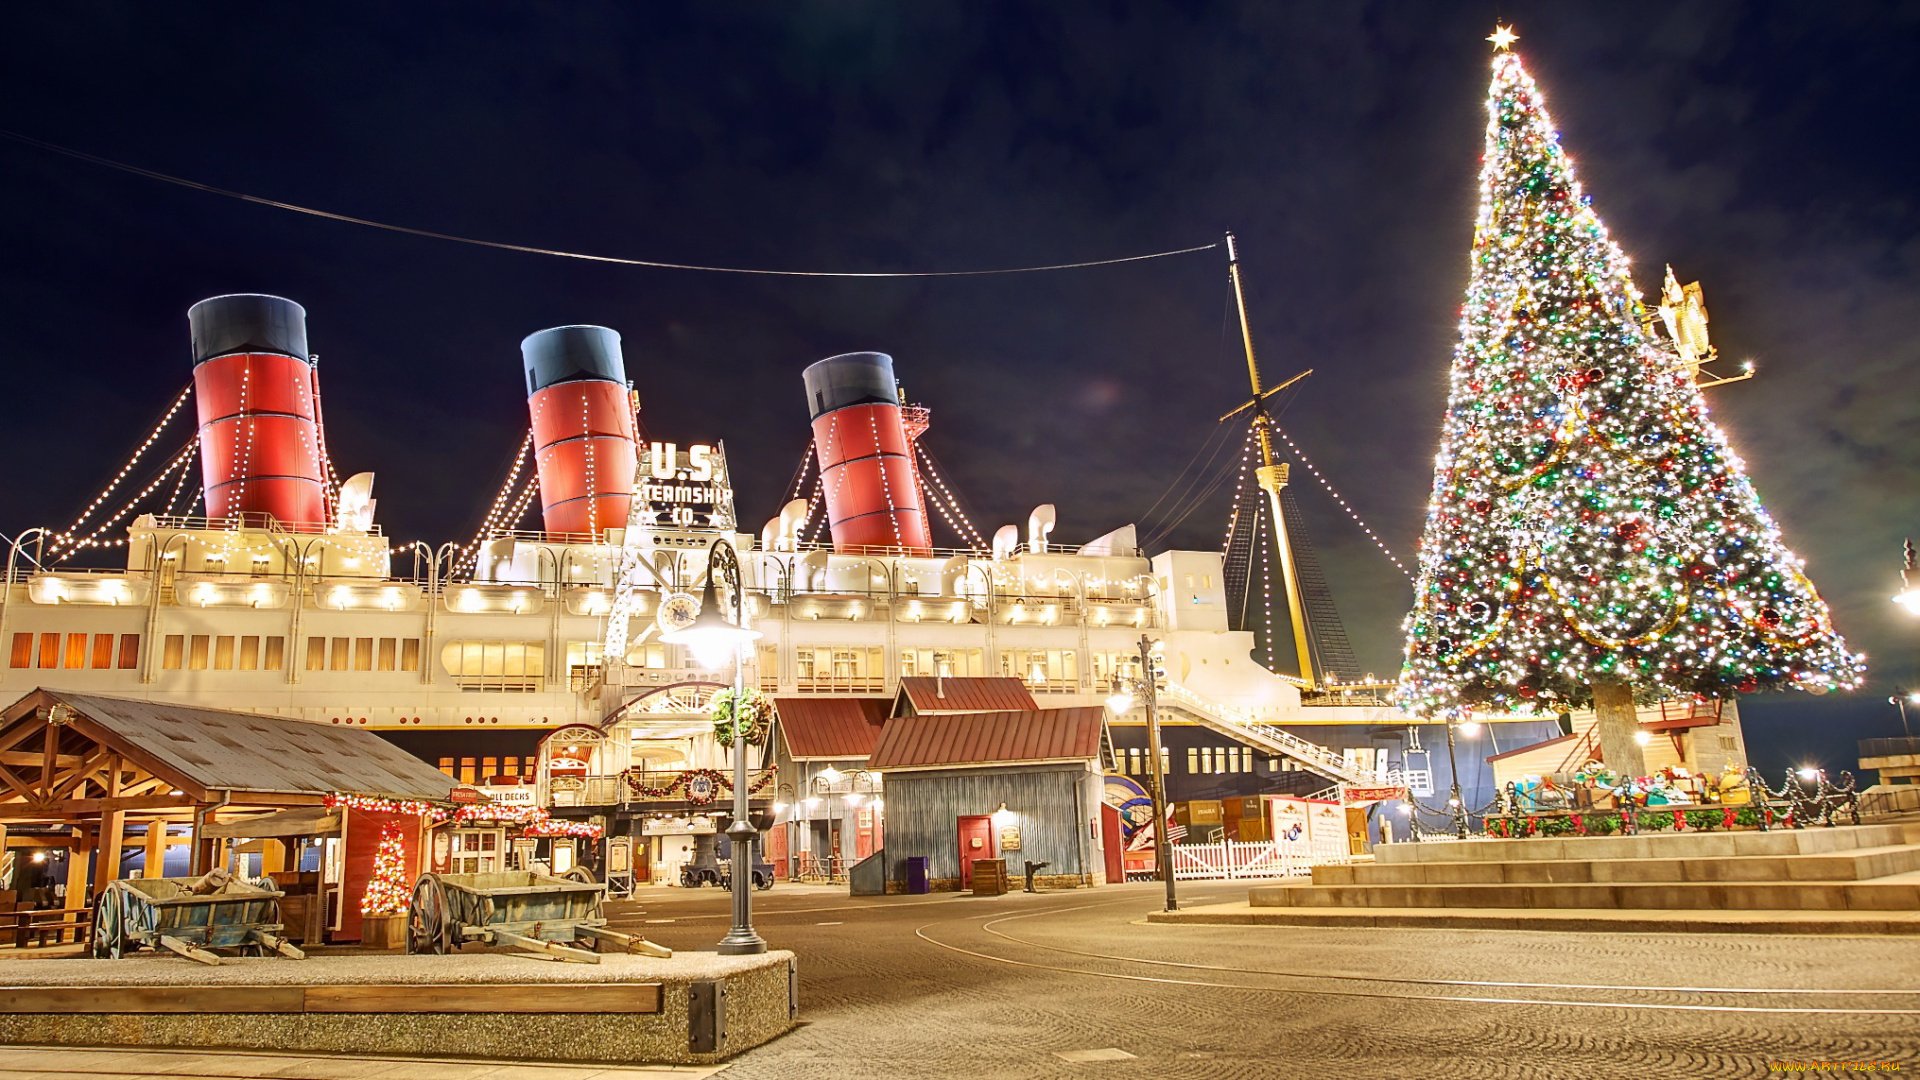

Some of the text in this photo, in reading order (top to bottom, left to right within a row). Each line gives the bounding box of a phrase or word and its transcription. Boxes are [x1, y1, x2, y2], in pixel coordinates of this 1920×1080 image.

[651, 442, 723, 482] U.S.
[632, 483, 734, 504] STEAMSHIP
[672, 507, 699, 525] CO.
[505, 792, 530, 801] DECKS
